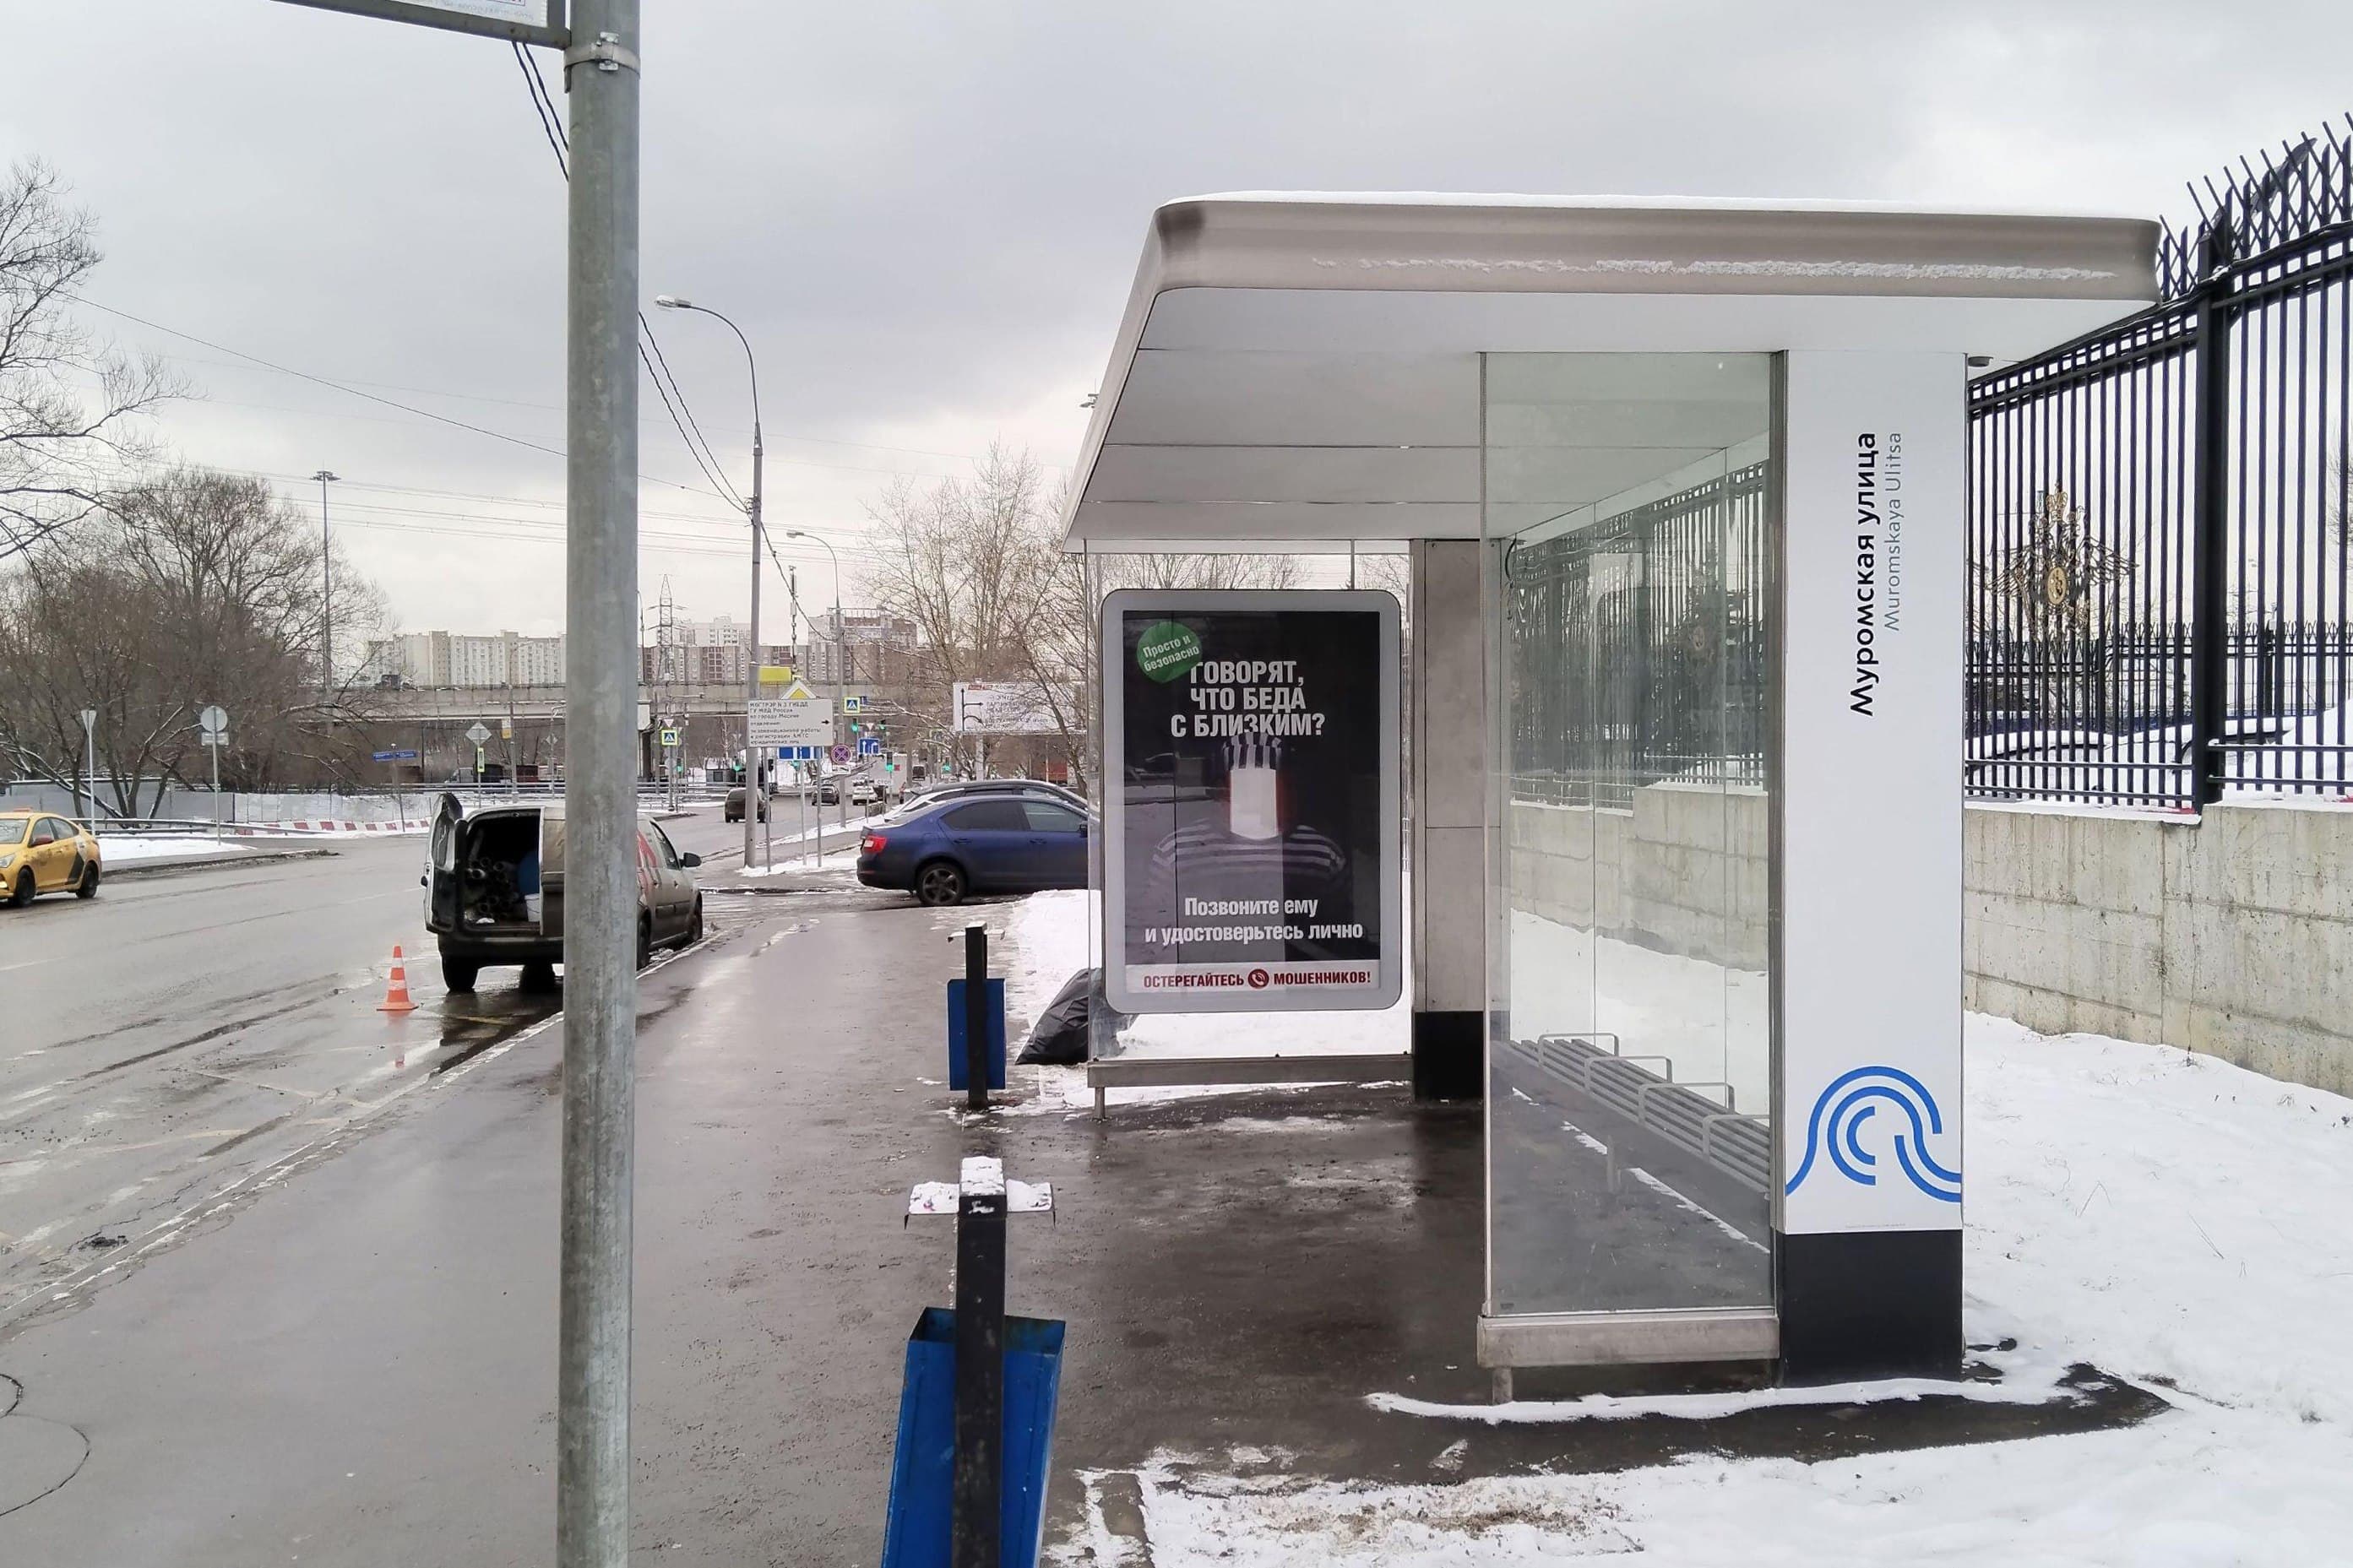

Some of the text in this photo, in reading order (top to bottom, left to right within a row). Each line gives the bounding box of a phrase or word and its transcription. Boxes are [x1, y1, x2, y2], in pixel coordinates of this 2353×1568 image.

[1884, 431, 1905, 632] Muromskaya Ulitsa
[1850, 431, 1880, 717] Муромская улица
[1143, 635, 1192, 659] Просто и
[1144, 645, 1200, 672] безопасно
[1190, 660, 1304, 686] ГОВОРЯТ,
[1190, 686, 1307, 713] ЧТО БЕДА
[1171, 713, 1325, 737] С БЛИЗКИМ?
[1185, 897, 1318, 918] Позвоните ему
[1145, 924, 1363, 947] и удостоверьтесь лично
[1144, 971, 1371, 989] ОСТЕРЕГАЙТЕСЬ МОШЕННИКОВ!
